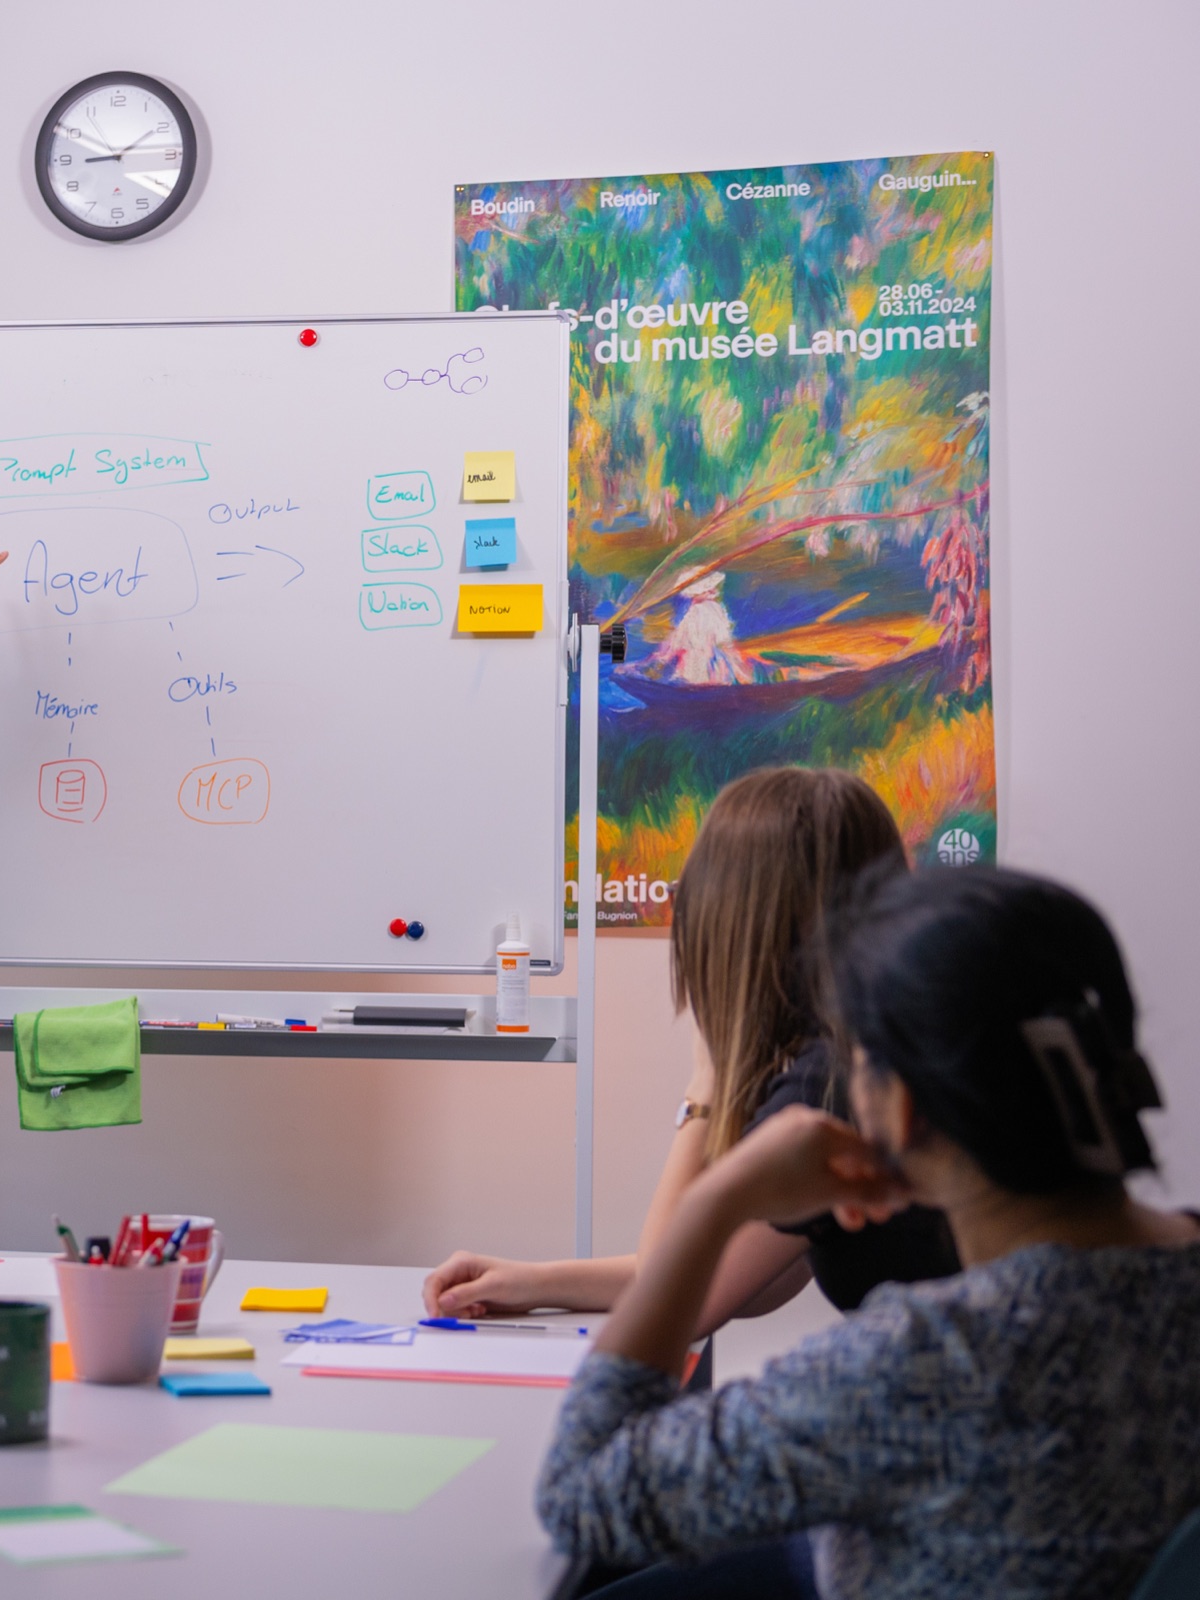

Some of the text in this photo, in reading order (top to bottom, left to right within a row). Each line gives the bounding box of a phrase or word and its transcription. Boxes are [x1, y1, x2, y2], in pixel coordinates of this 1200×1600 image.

[110, 95, 127, 107] 12
[156, 121, 170, 134] 2
[59, 154, 73, 166] 9
[164, 149, 177, 161] 3
[66, 180, 79, 192] 8
[471, 170, 977, 216] Boudin Renoir Cézanne Gauguin...
[85, 201, 97, 216] 7
[110, 207, 125, 219] 6
[135, 198, 150, 210] 5
[879, 283, 933, 301] 28.06
[879, 297, 977, 317] 03.11.2024
[595, 317, 978, 364] du musée Langmatt
[95, 448, 187, 485] System
[208, 498, 301, 525] Output
[368, 532, 429, 557] Slack
[23, 539, 149, 616] Agent
[167, 671, 238, 703] Outils
[34, 690, 99, 719] Mémoire
[196, 772, 253, 811] MCP
[943, 829, 973, 849] 40
[597, 911, 638, 922] Bugnion
